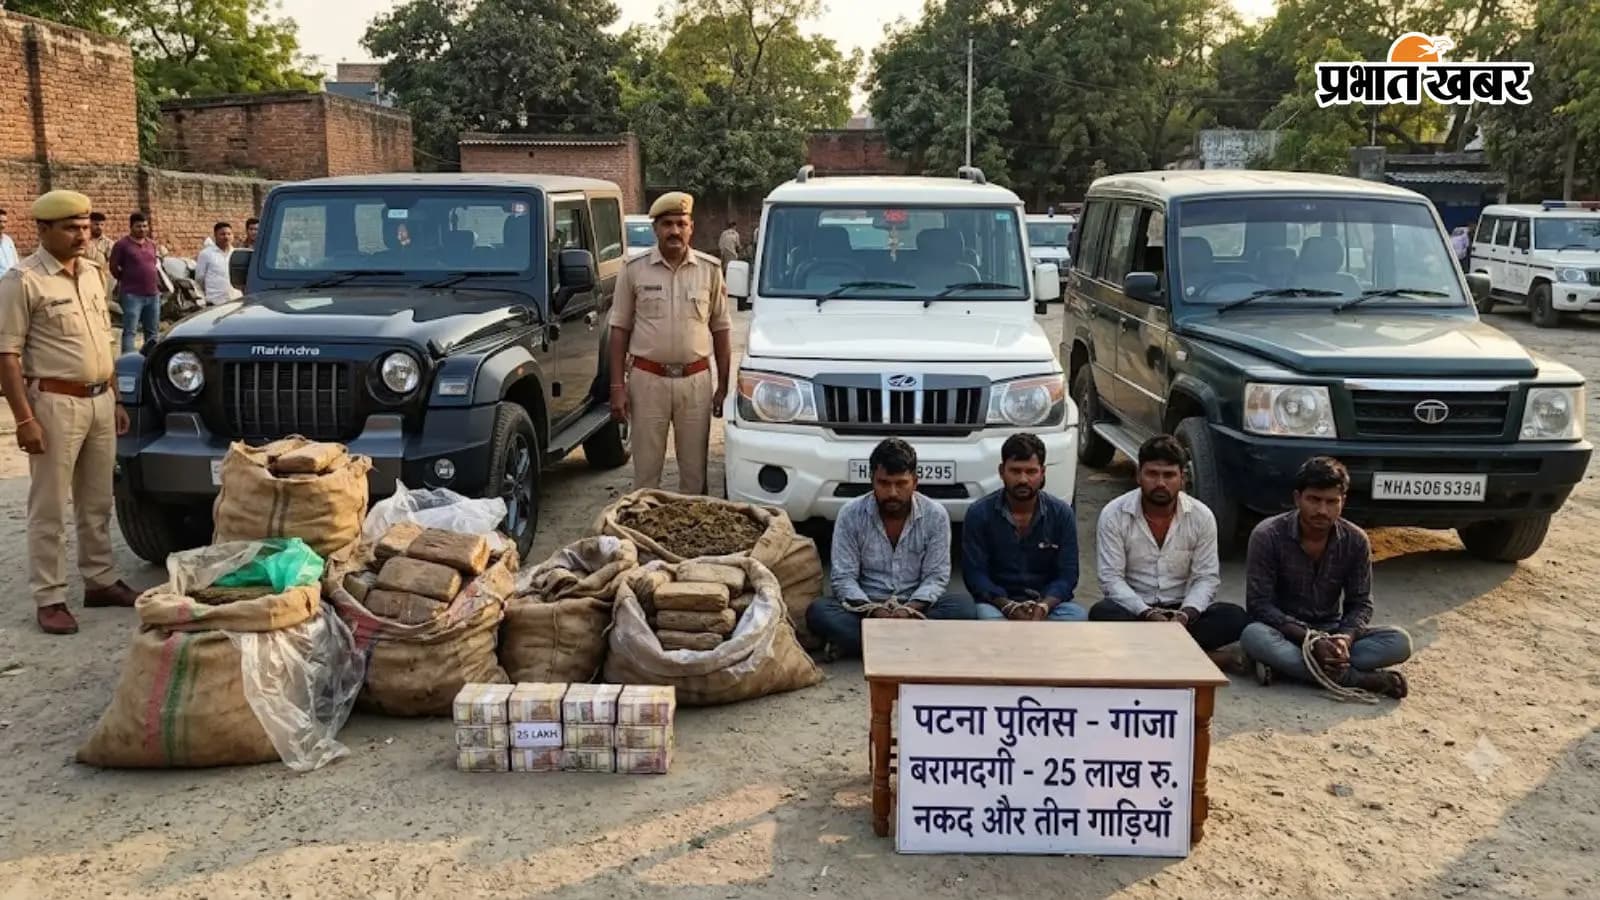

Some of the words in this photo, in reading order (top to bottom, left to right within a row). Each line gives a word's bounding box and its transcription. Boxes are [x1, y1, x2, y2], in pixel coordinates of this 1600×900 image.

[517, 730, 529, 740] 25
[531, 729, 558, 739] LAKH
[912, 705, 987, 735] पटना
[994, 695, 1078, 747] पुलिस
[1108, 699, 1178, 739] गांजा
[909, 747, 1015, 789] बरामदगी
[1044, 757, 1076, 787] 25
[1083, 759, 1142, 789] लाख
[1148, 761, 1178, 789] रु.
[912, 805, 974, 838] नकद
[982, 794, 1027, 836] और
[1033, 796, 1081, 836] तीन
[1087, 796, 1173, 845] गाड़ियाँ
